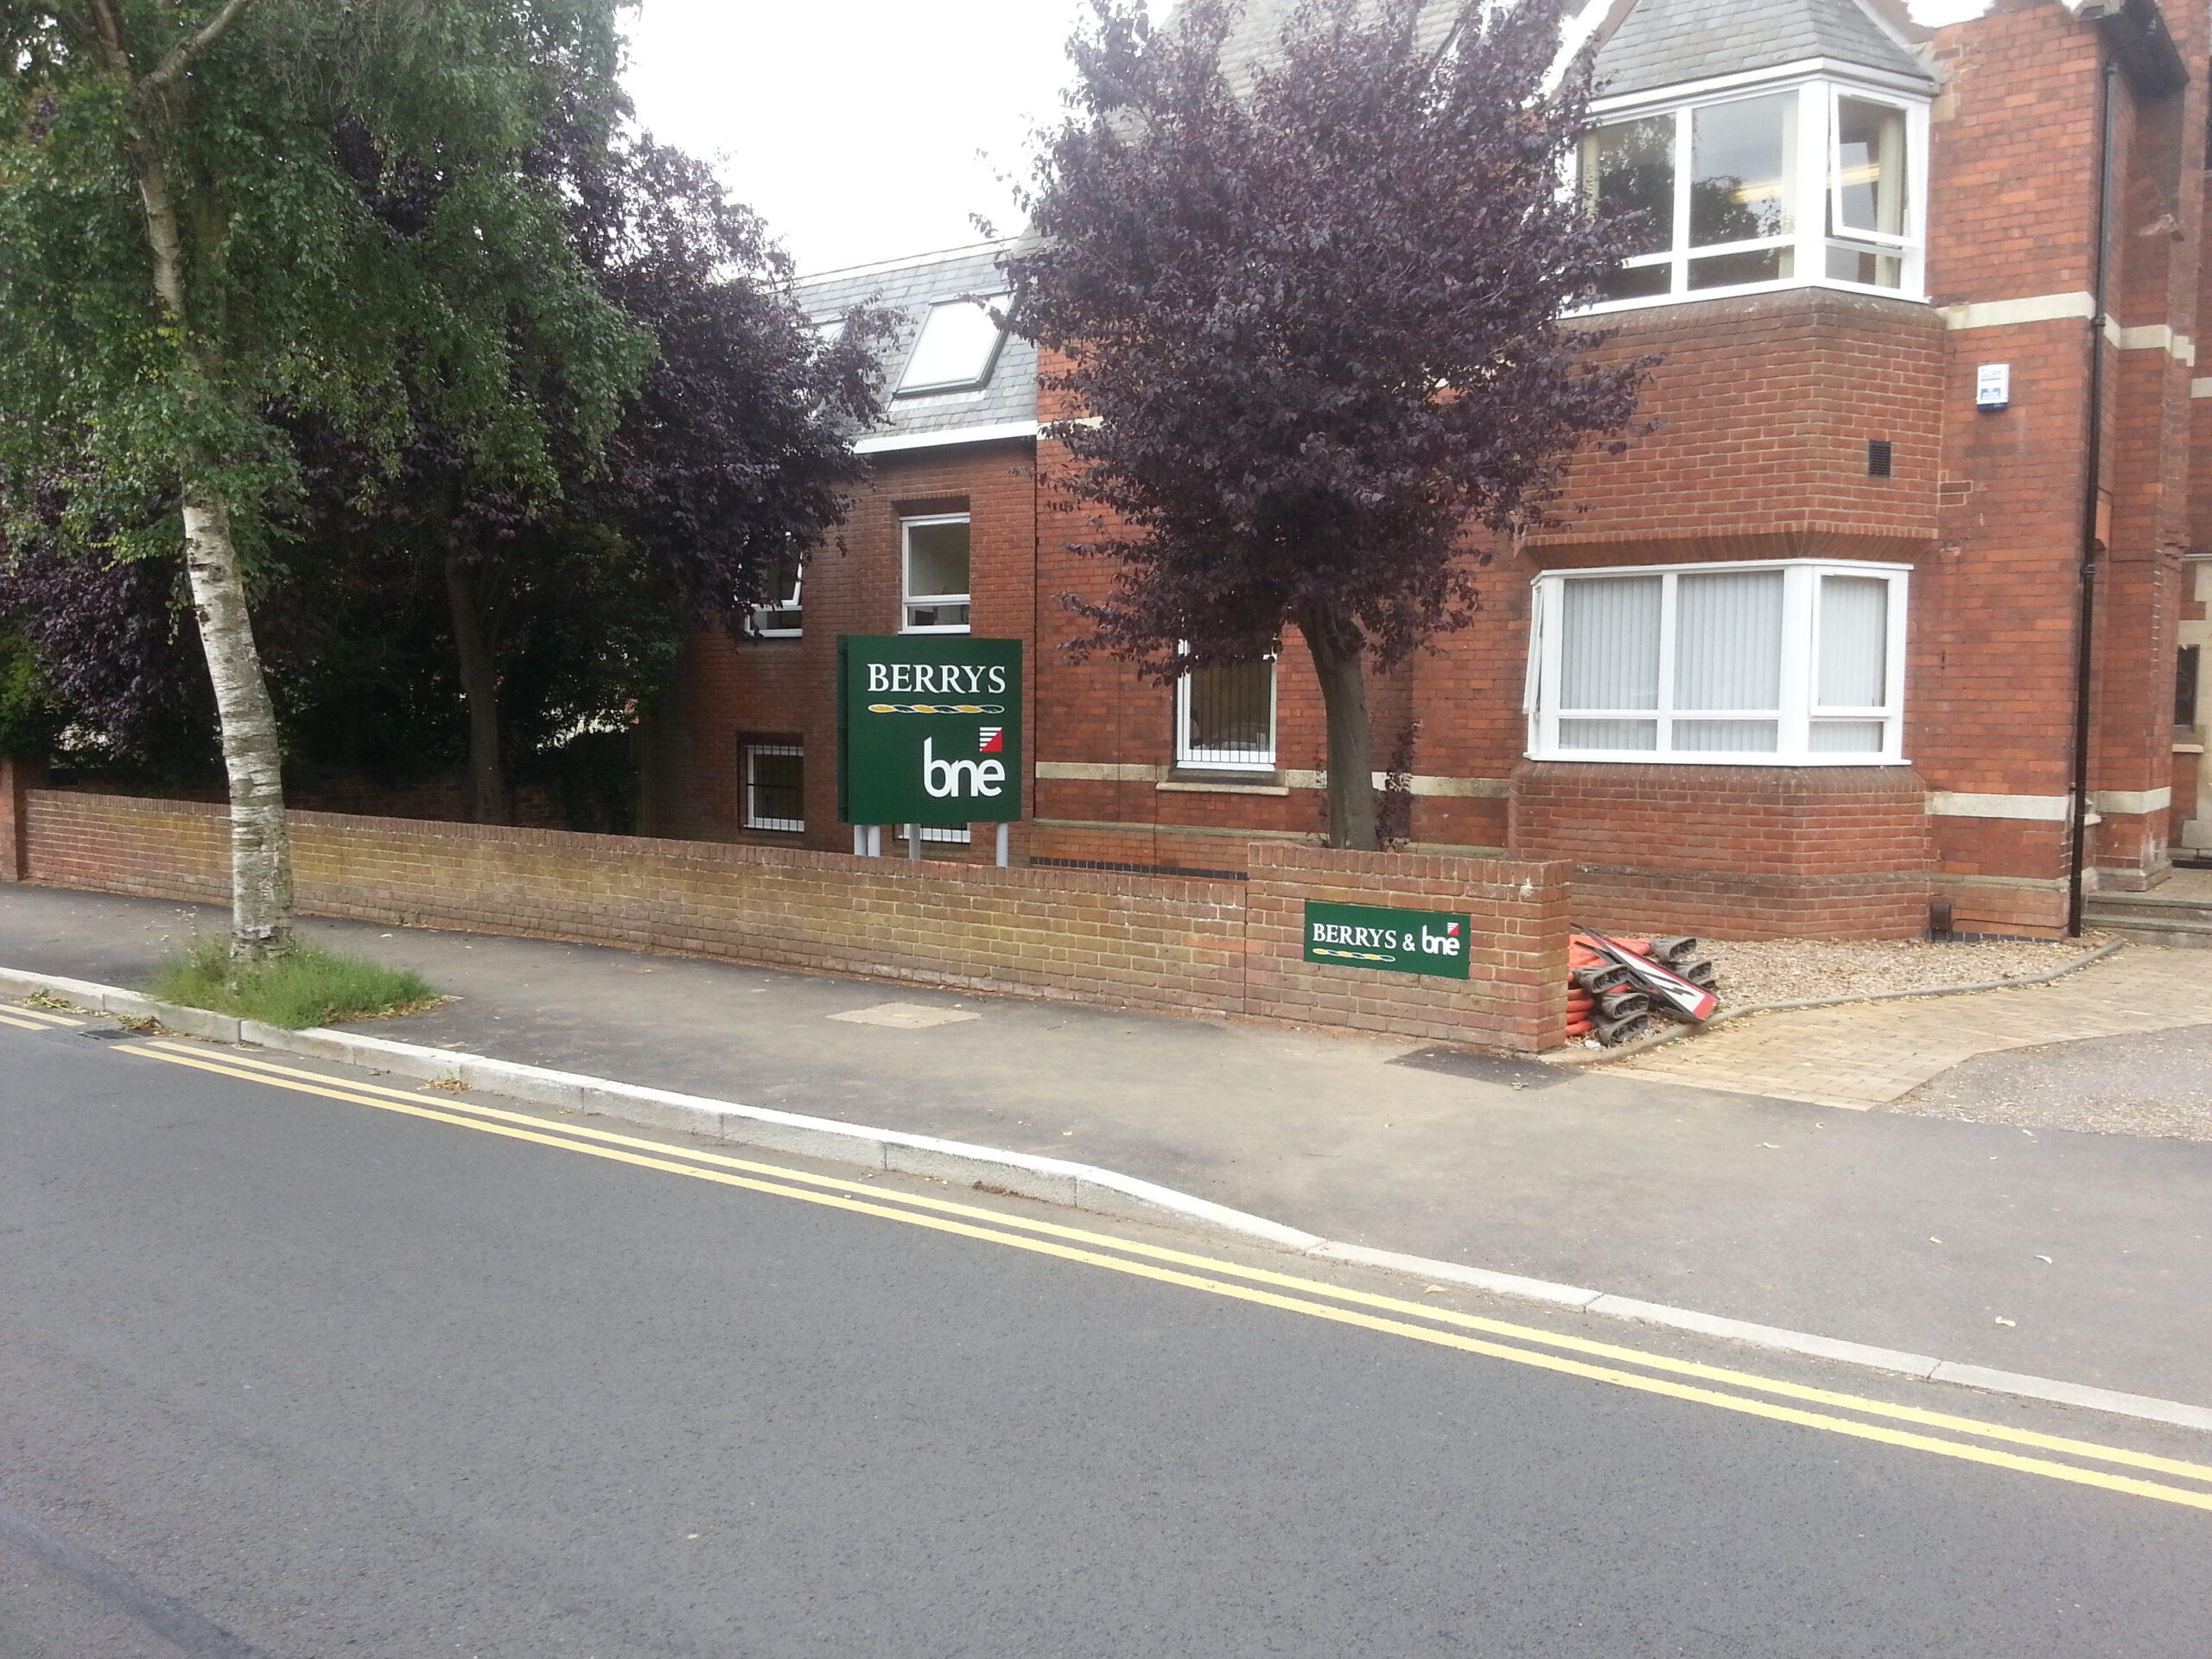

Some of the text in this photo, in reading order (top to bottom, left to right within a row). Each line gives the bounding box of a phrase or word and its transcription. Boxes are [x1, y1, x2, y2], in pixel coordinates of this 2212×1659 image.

[868, 664, 1006, 694] BERRYS
[924, 736, 1006, 798] bne
[1313, 923, 1460, 956] BERRYS & bne
